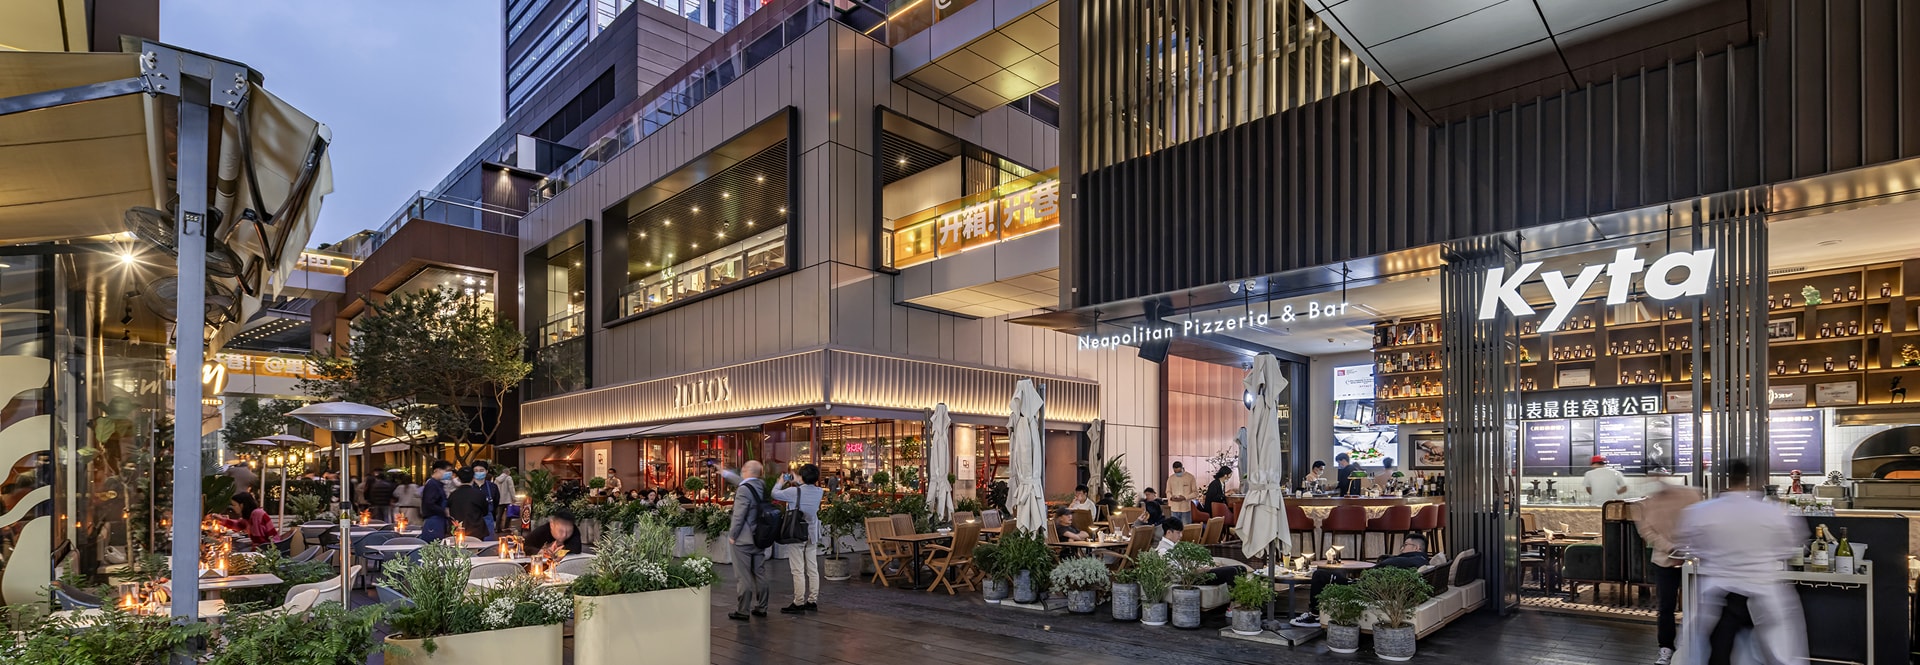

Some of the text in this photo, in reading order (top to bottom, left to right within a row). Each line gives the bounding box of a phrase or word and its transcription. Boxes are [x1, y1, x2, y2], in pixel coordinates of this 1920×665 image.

[940, 199, 996, 246] 开箱!
[1478, 247, 1716, 333] Kyta
[1077, 300, 1349, 351] Neapolitan Pizzeria & Bar
